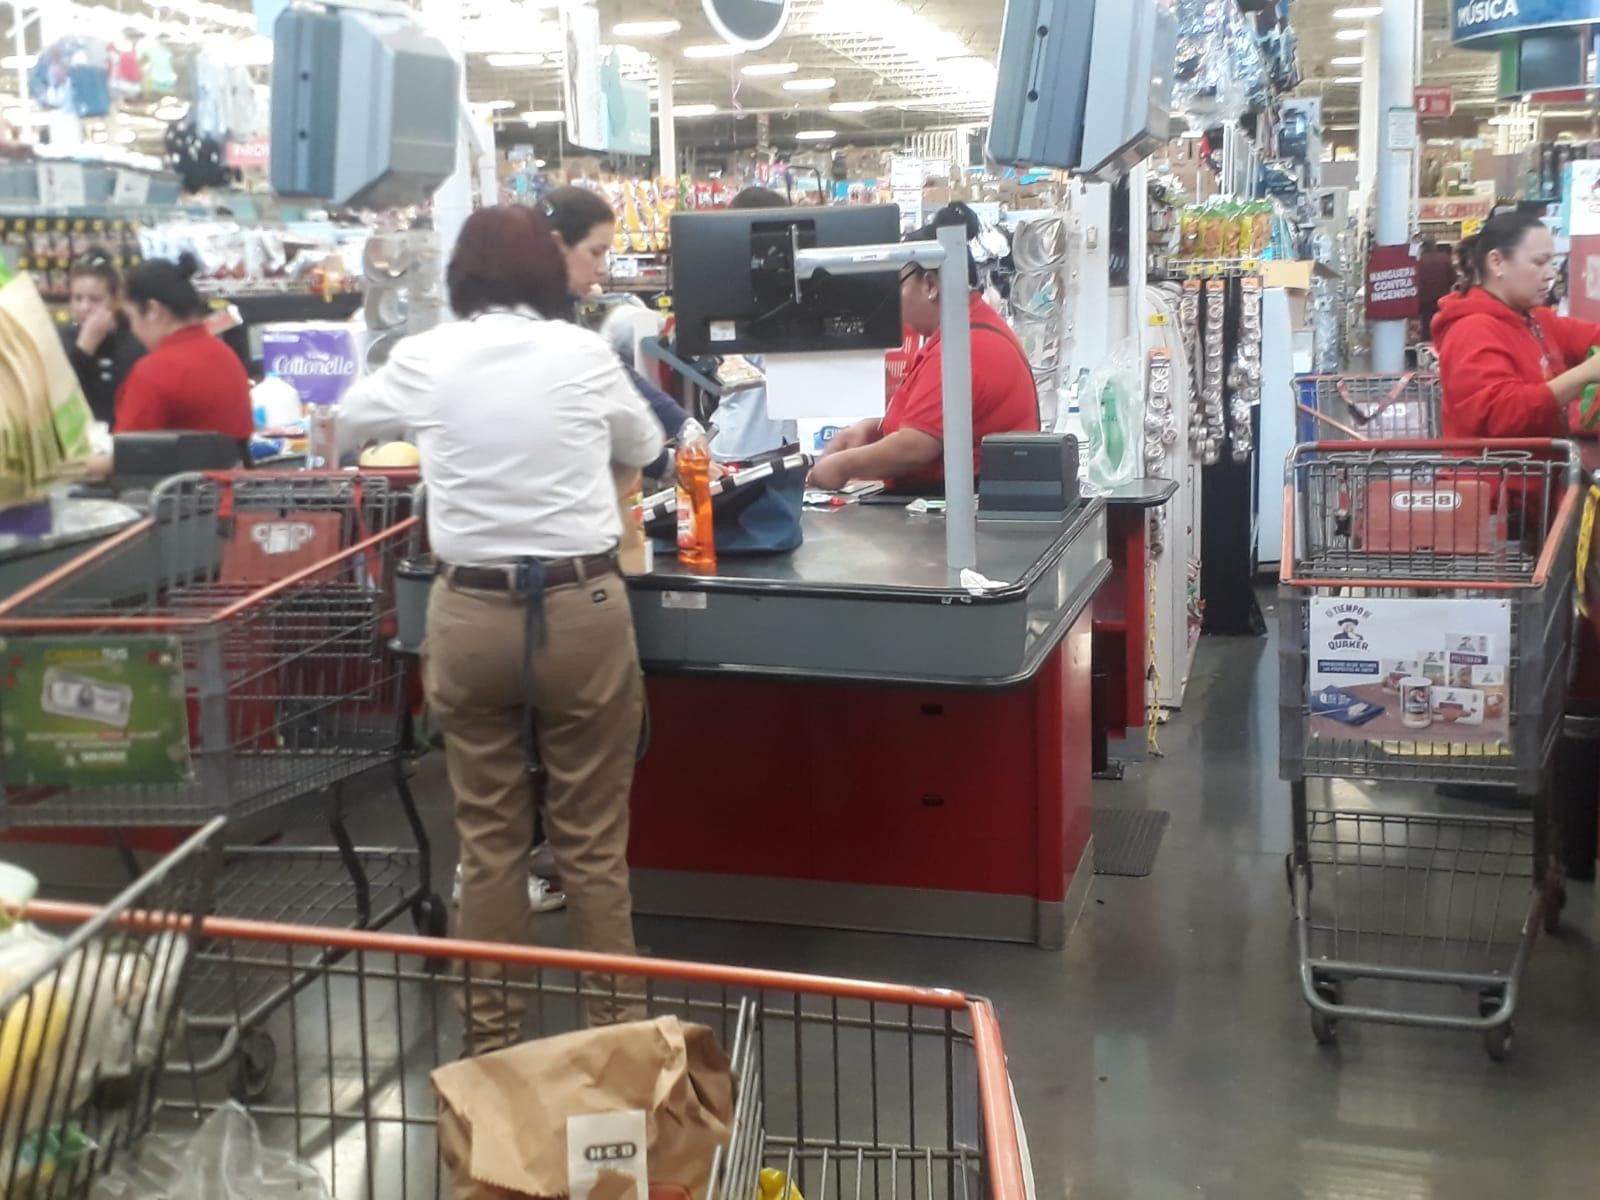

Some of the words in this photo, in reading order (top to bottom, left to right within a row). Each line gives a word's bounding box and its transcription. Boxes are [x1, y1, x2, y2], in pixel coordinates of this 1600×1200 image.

[1457, 0, 1519, 27] MÚSICA
[1369, 267, 1416, 283] MANGUERA
[1374, 278, 1414, 291] CONTRA
[1371, 286, 1417, 302] INCENDIO
[273, 354, 354, 376] Cottonelle
[1332, 604, 1364, 616] TIEMPO
[1328, 640, 1369, 651] QUAKER
